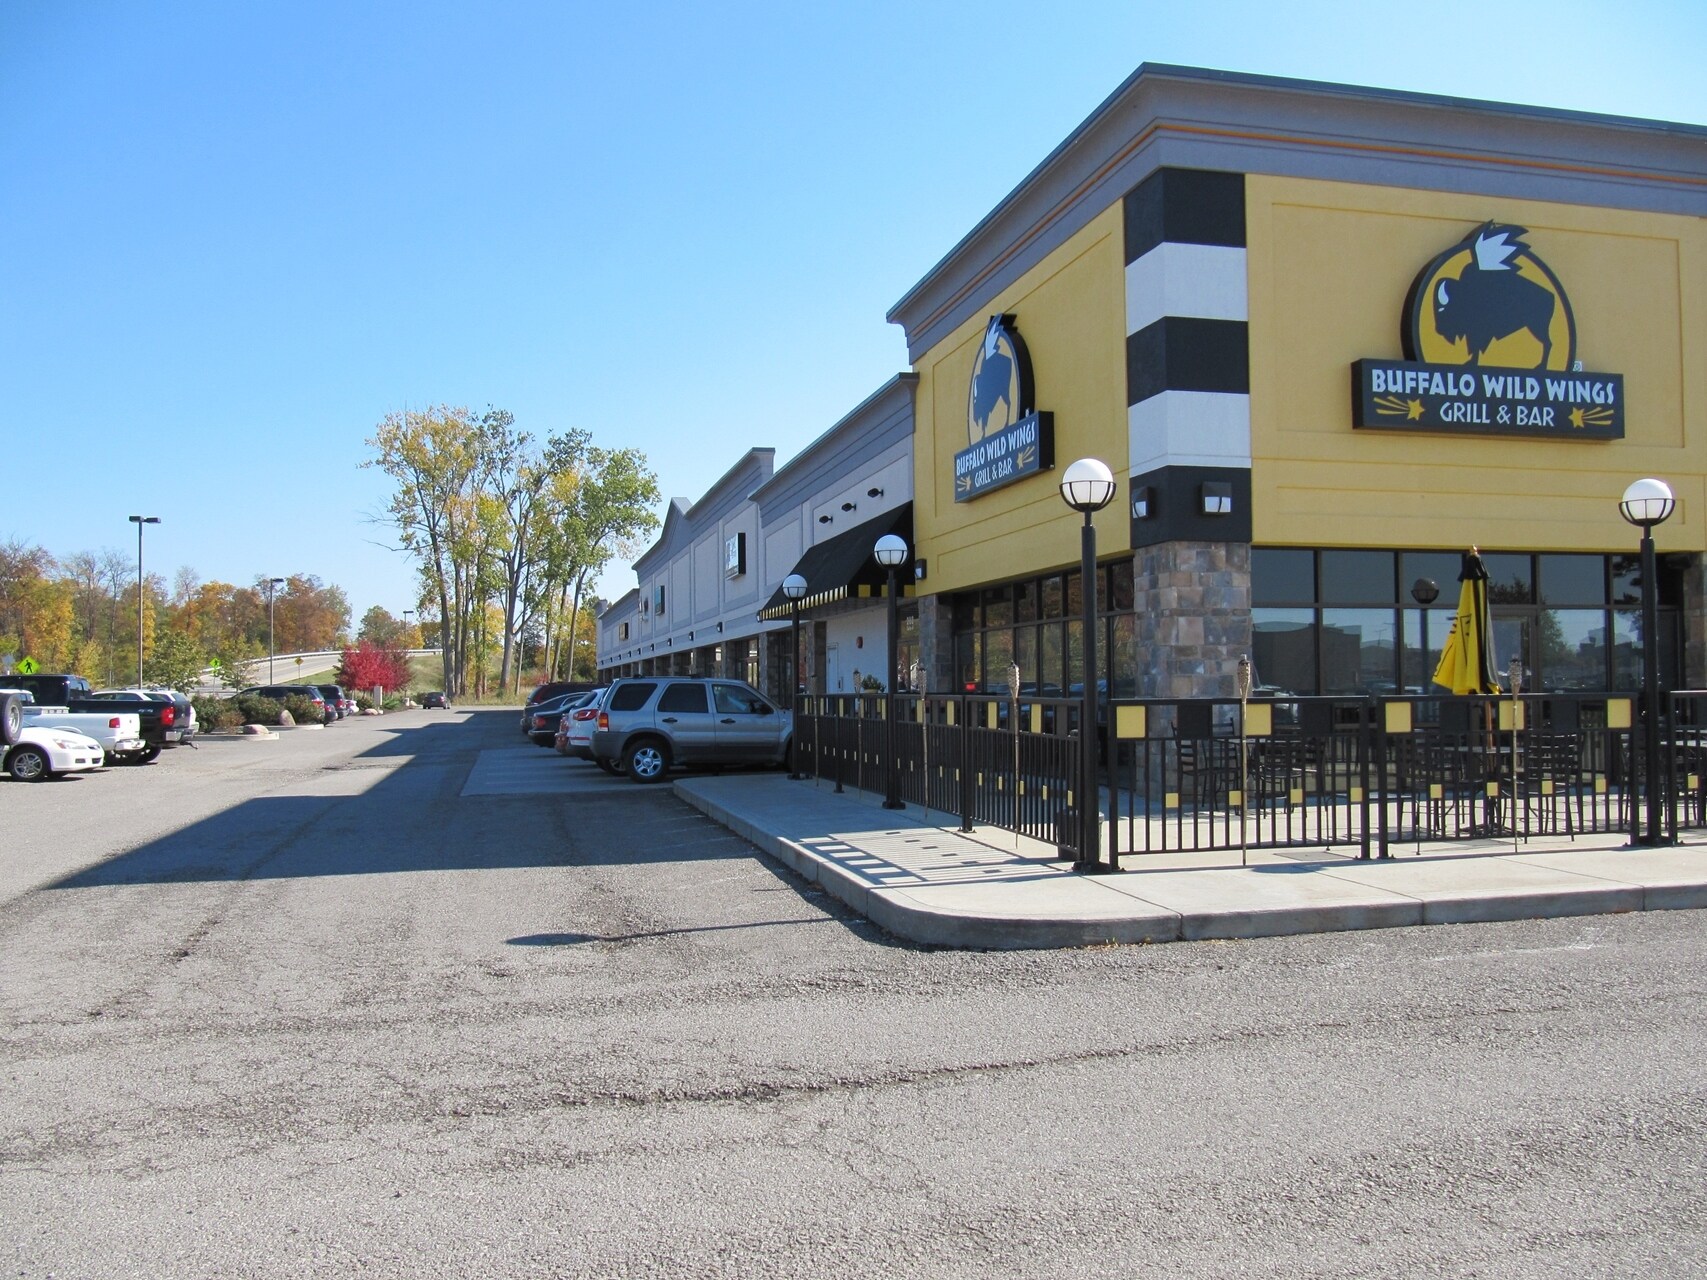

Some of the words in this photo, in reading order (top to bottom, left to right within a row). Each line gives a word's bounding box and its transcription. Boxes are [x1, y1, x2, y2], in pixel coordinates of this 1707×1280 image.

[1372, 369, 1475, 397] BUFFALO
[1482, 374, 1540, 400] WILD
[1546, 378, 1614, 405] WINGS
[1439, 402, 1491, 424] GRILL
[1496, 404, 1511, 425] &
[1516, 406, 1555, 427] BAR
[956, 446, 985, 476] BUFFALO
[986, 436, 1006, 461] WILD
[1008, 421, 1035, 452] WINGS
[974, 467, 991, 487] GRILL
[991, 464, 998, 480] &
[997, 457, 1013, 478] BAR
